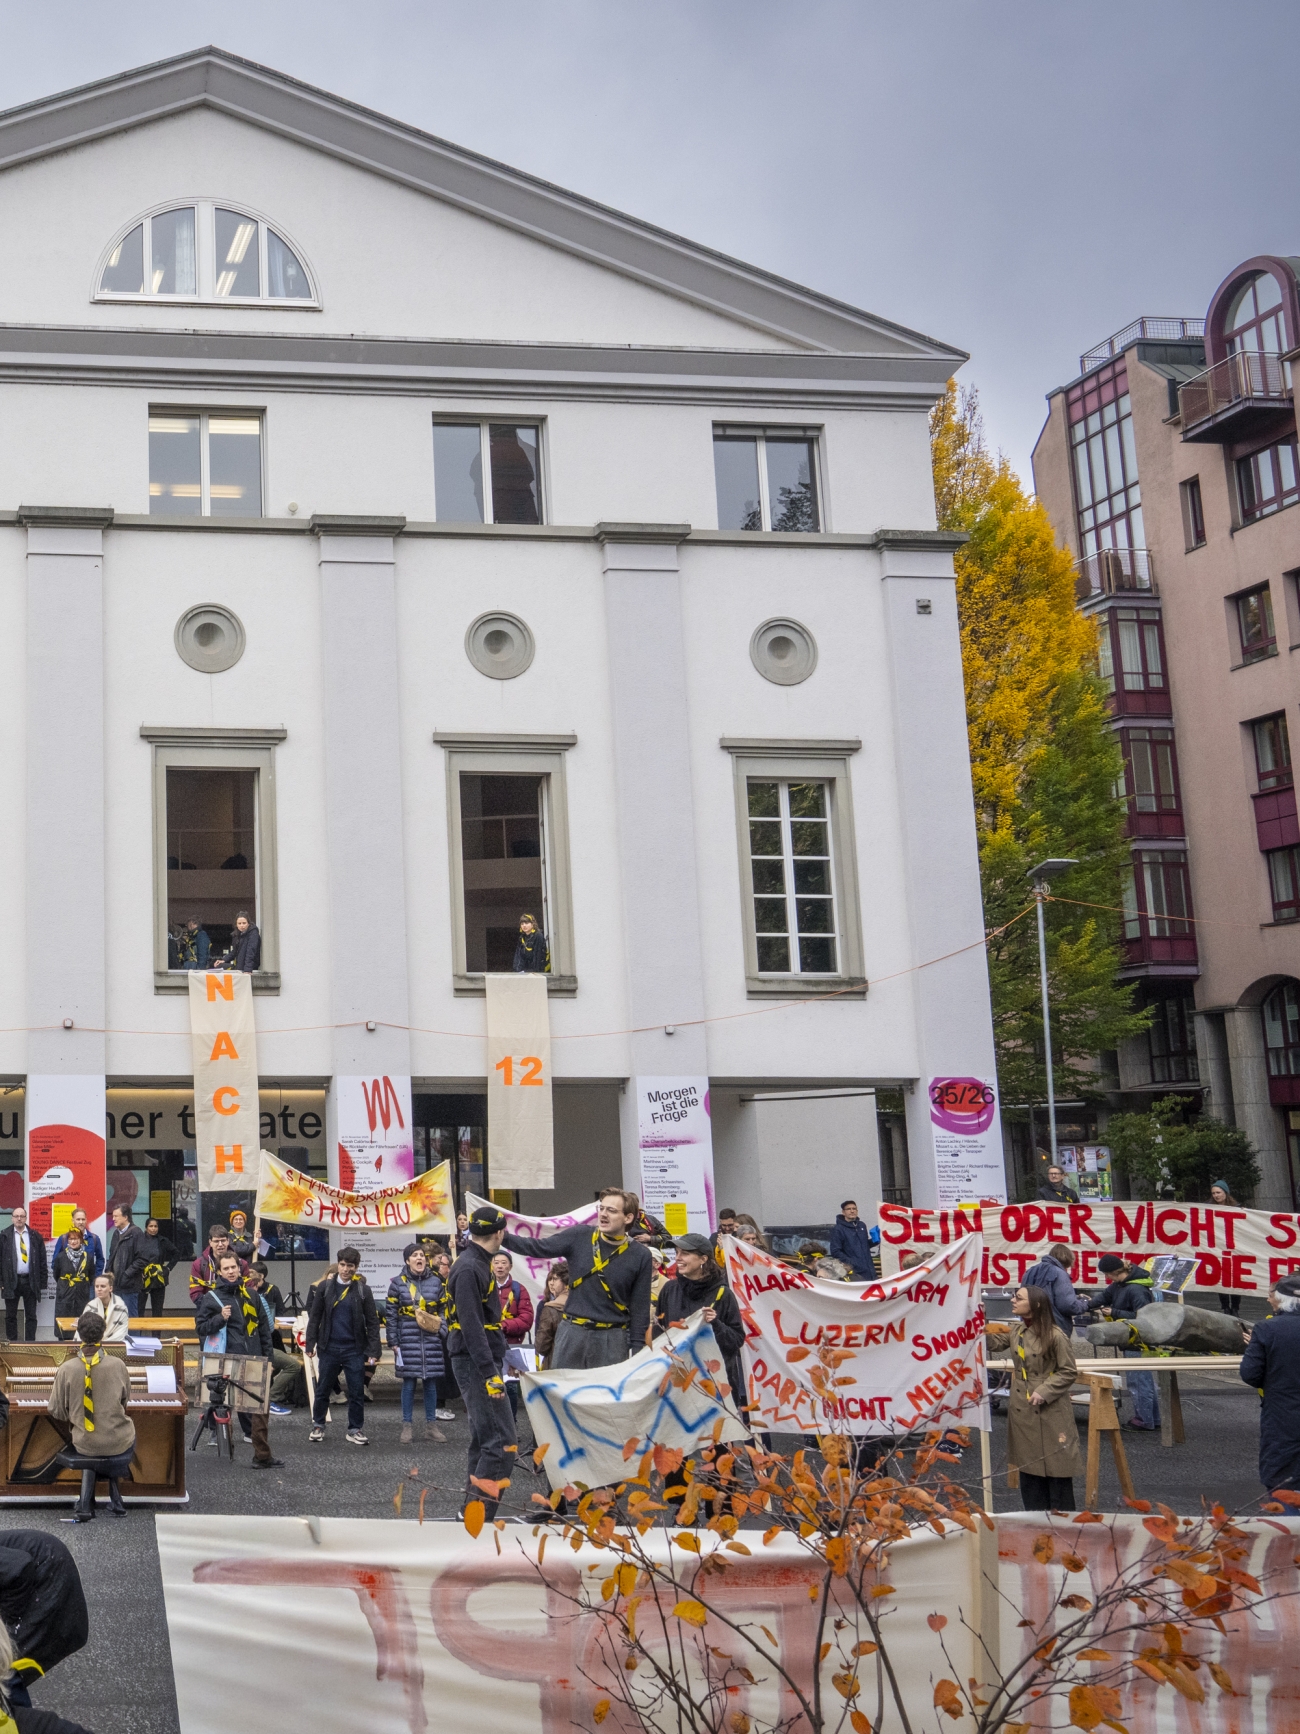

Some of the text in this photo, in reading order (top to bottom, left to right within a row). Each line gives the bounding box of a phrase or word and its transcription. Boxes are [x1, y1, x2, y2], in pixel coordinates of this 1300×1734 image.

[495, 1056, 543, 1086] 12
[647, 1086, 697, 1103] Morgen
[661, 1096, 699, 1112] ist die
[931, 1086, 995, 1104] 25/26
[651, 1109, 688, 1124] Frage
[879, 1204, 982, 1244] SEIN
[1000, 1204, 1101, 1245] ODER
[1265, 1213, 1300, 1249] S
[743, 1271, 950, 1307] ALARM ALARM
[772, 1309, 906, 1349] LUZERN
[752, 1358, 973, 1421] DARF NICHT MEHR
